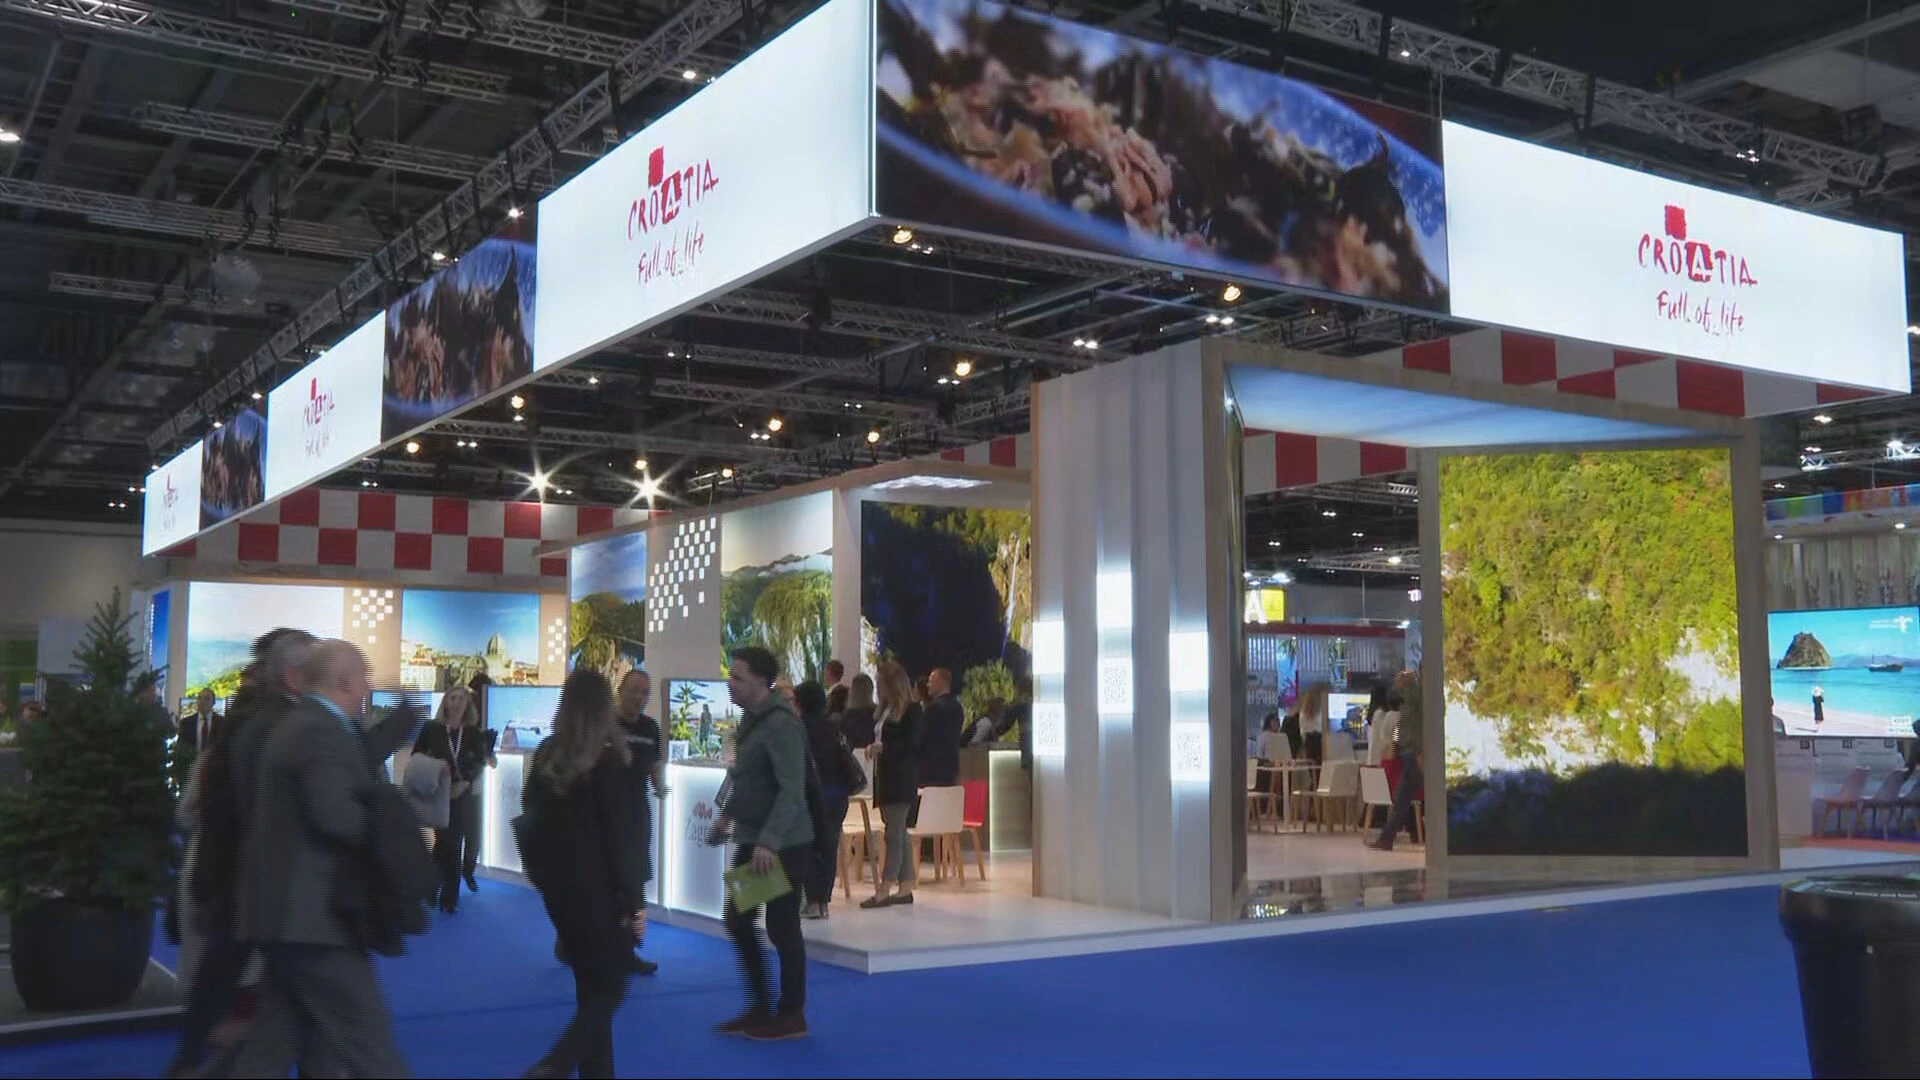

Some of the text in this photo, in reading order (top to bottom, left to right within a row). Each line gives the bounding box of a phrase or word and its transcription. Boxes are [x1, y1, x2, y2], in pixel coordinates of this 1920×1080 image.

[627, 158, 719, 241] CROATIA
[638, 240, 662, 285] Full
[685, 220, 704, 267] life
[1638, 233, 1758, 288] CROATIA
[1657, 290, 1691, 325] Full
[1720, 300, 1745, 336] life
